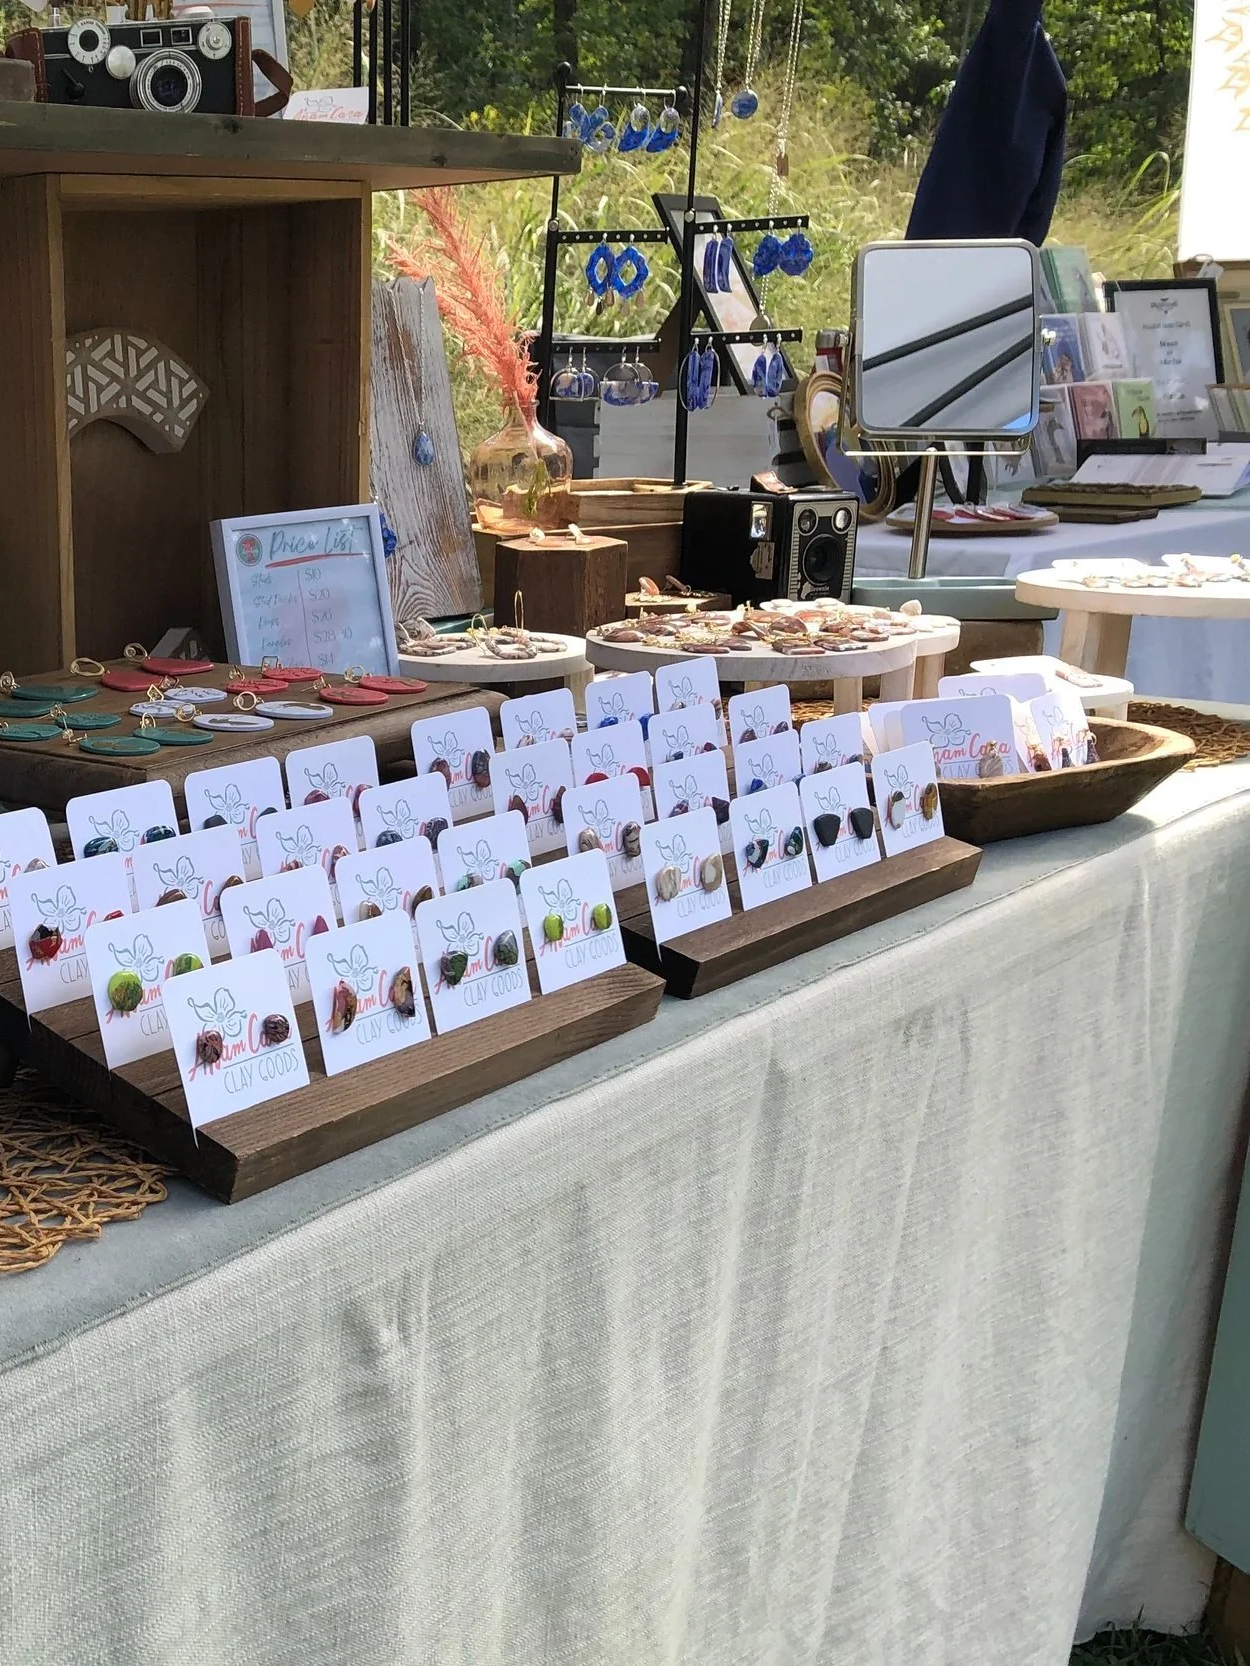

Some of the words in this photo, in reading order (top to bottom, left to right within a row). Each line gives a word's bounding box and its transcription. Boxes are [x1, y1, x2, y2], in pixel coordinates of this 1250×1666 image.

[270, 530, 319, 560] Price
[325, 525, 363, 556] List
[934, 748, 967, 765] nam
[969, 732, 1011, 759] Caa
[463, 981, 488, 1007] CLAY
[491, 967, 524, 997] GOODS
[355, 1015, 383, 1045] CLAY
[223, 1063, 254, 1094] CLAY
[258, 1047, 300, 1082] GOODS
